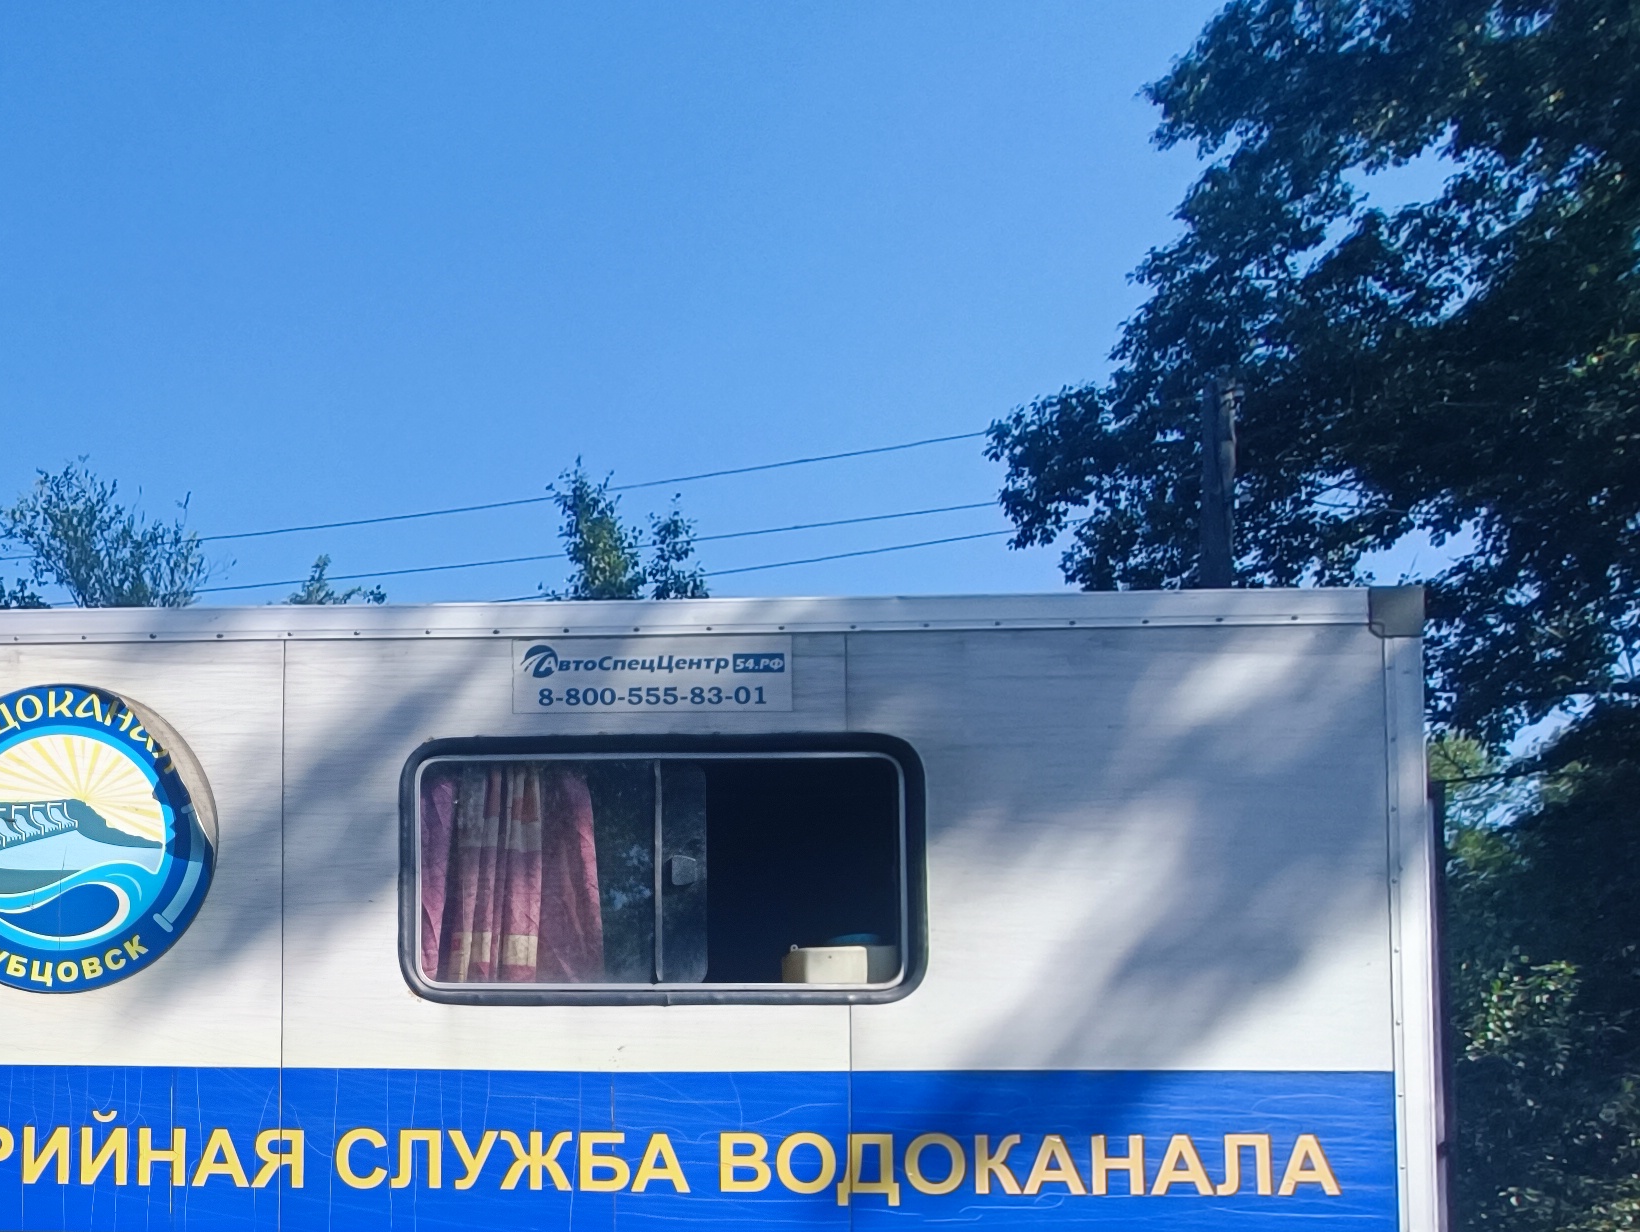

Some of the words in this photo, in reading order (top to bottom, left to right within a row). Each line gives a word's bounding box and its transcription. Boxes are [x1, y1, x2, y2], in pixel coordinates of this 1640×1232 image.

[532, 648, 730, 677] АвтоСпецЦентр
[733, 653, 785, 673] 54.РФ
[537, 685, 767, 707] 8-800-555-83-01
[334, 1127, 691, 1193] СЛУЖБА
[718, 1131, 1342, 1206] ВОДОКАНАЛА
